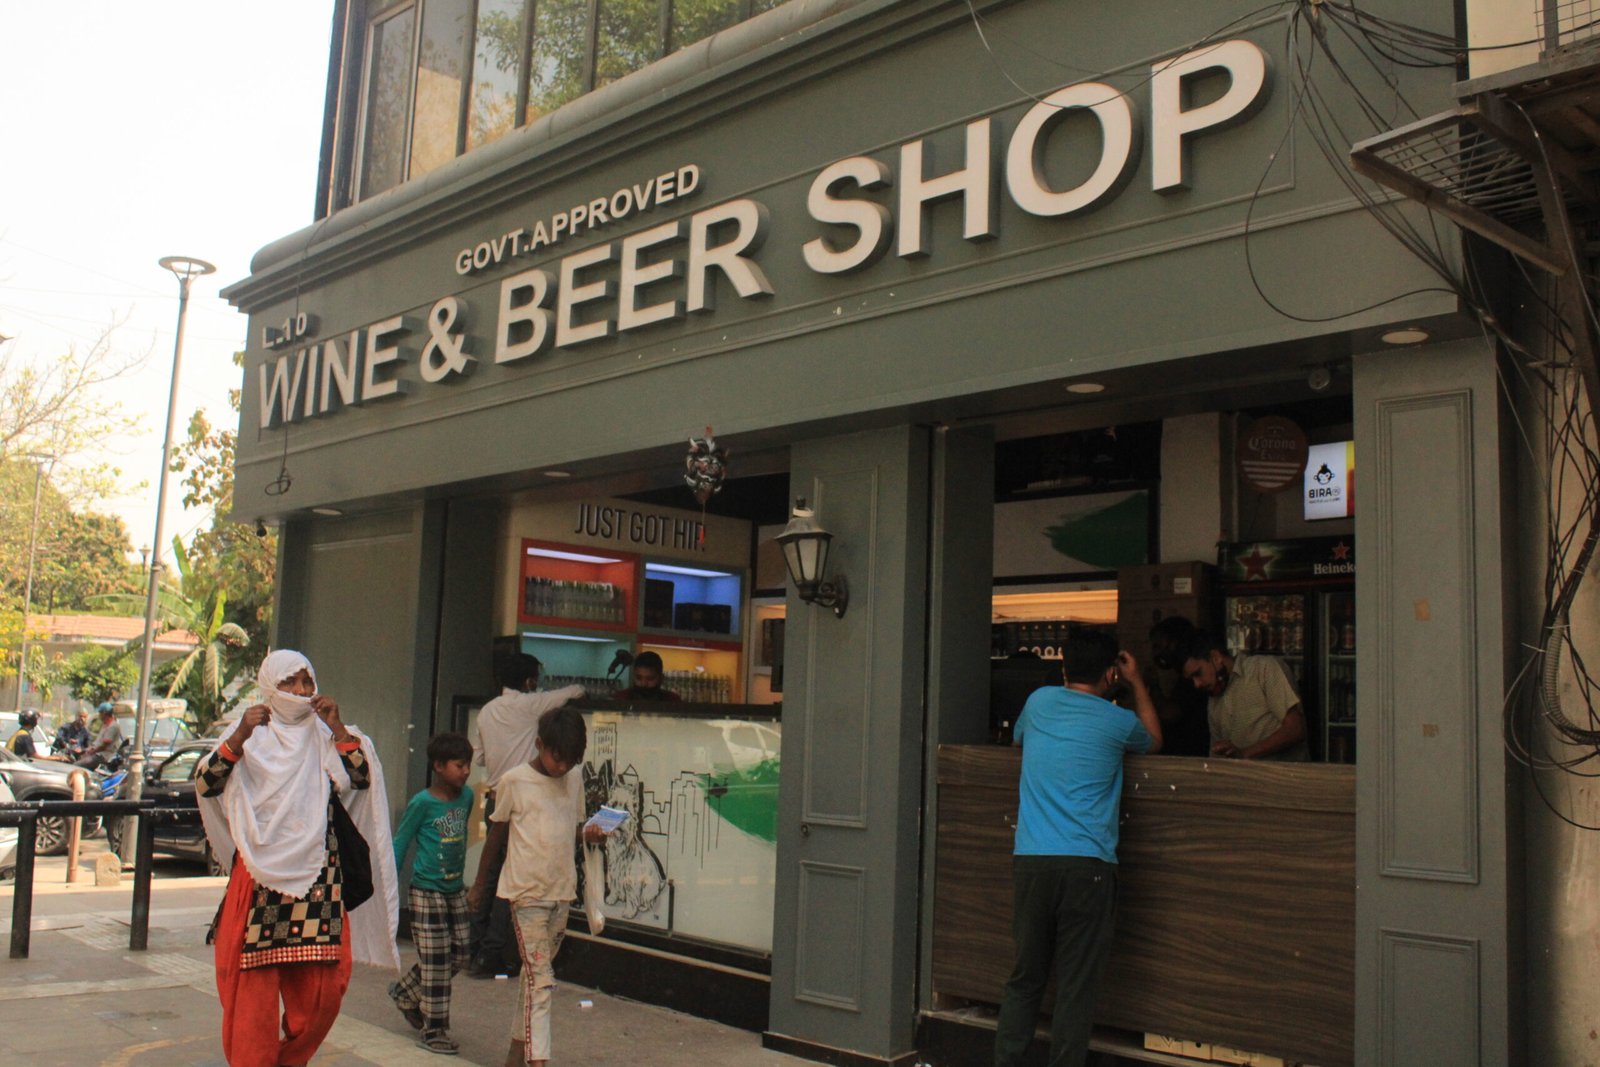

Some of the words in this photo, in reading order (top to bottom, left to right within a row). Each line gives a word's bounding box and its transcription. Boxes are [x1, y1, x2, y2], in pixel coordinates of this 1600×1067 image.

[258, 315, 408, 430] WINE
[420, 296, 474, 384] &
[495, 198, 774, 365] BEER
[802, 40, 1267, 274] SHOP
[456, 163, 701, 276] GOVT.APPROVED
[574, 503, 626, 540] JUST
[630, 512, 670, 546] GOT
[1308, 488, 1332, 499] BIRA
